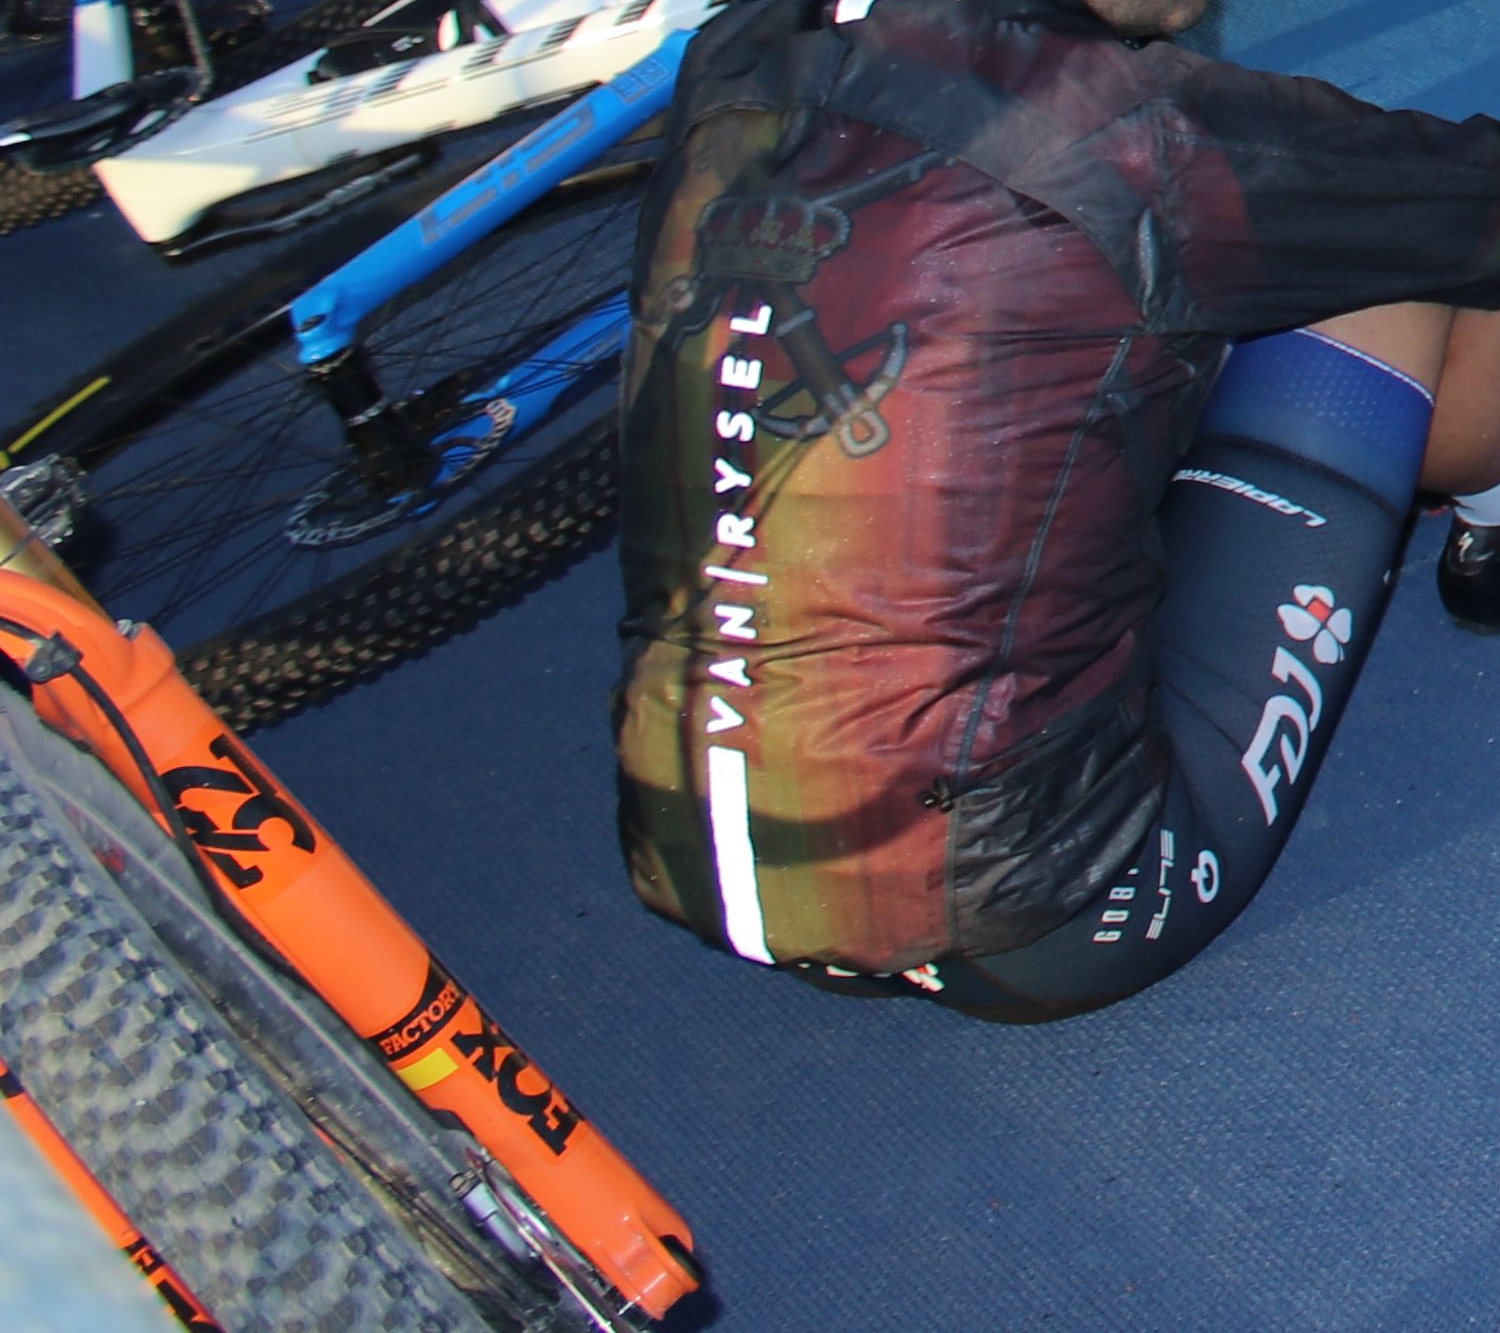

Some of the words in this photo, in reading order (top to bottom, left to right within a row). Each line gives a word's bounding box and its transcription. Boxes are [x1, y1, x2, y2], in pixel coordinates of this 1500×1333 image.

[713, 302, 774, 550] RYSEL
[704, 604, 757, 735] VAN
[1241, 646, 1329, 826] FDJ
[380, 978, 460, 1056] FACTORY
[449, 1009, 585, 1158] FOX
